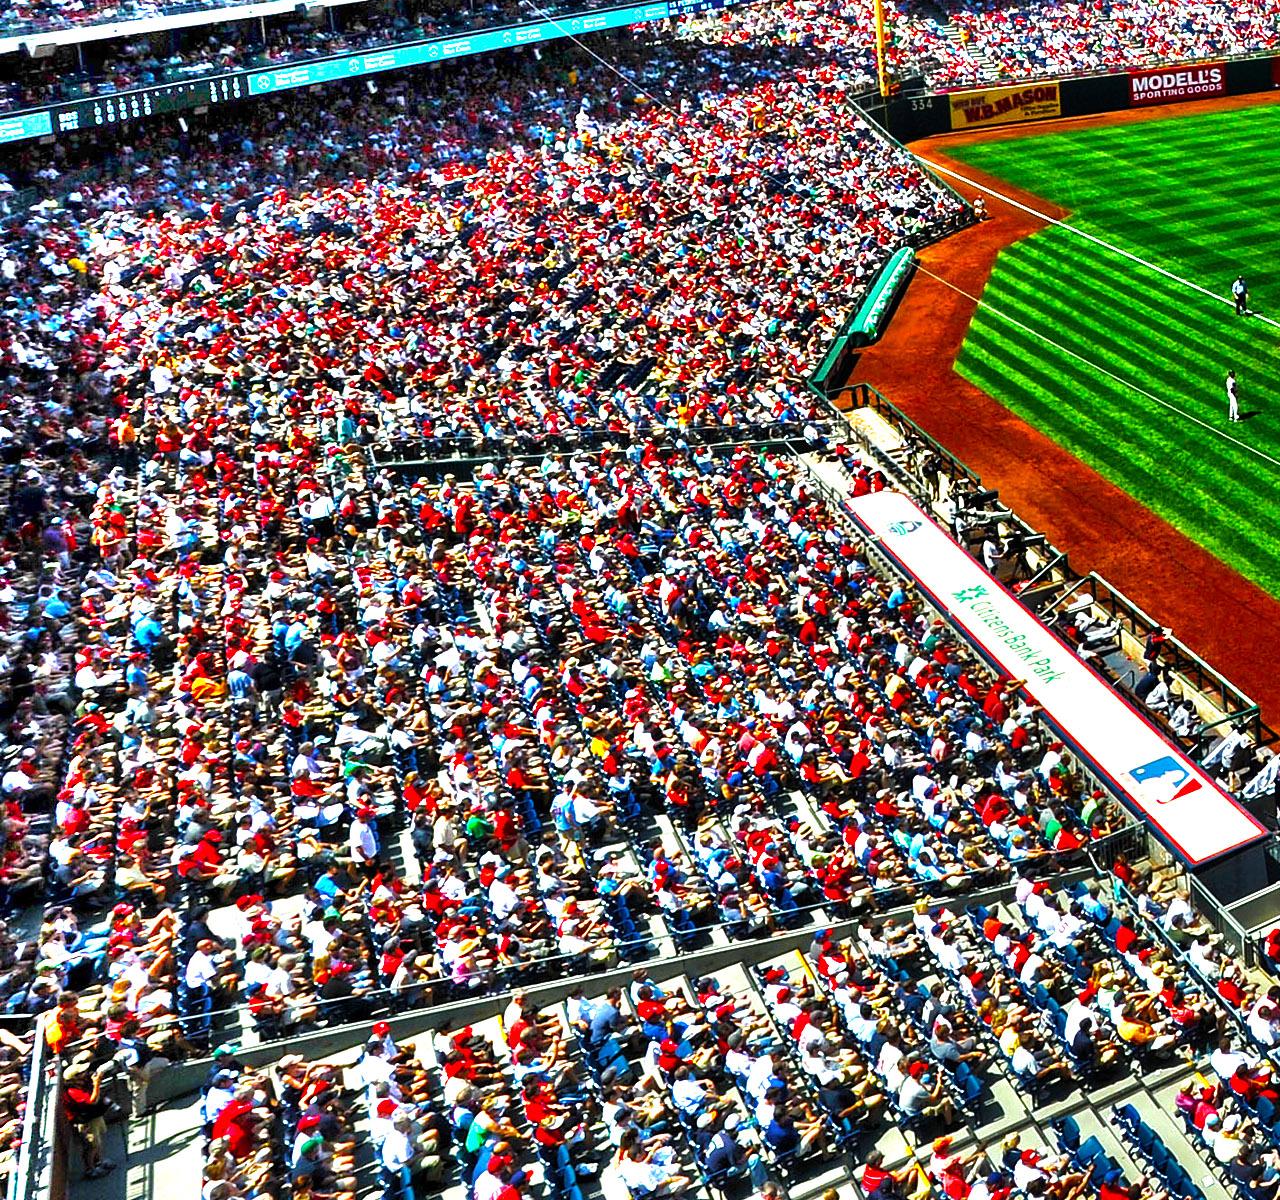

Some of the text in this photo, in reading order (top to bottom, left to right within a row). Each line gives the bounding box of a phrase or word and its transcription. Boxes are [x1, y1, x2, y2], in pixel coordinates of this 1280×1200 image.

[1131, 68, 1222, 92] MODELL'S
[1133, 82, 1223, 101] SPORTING GOODS
[911, 98, 933, 111] 334
[58, 111, 78, 123] BOS
[970, 601, 1066, 685] Citizens Bank Park
